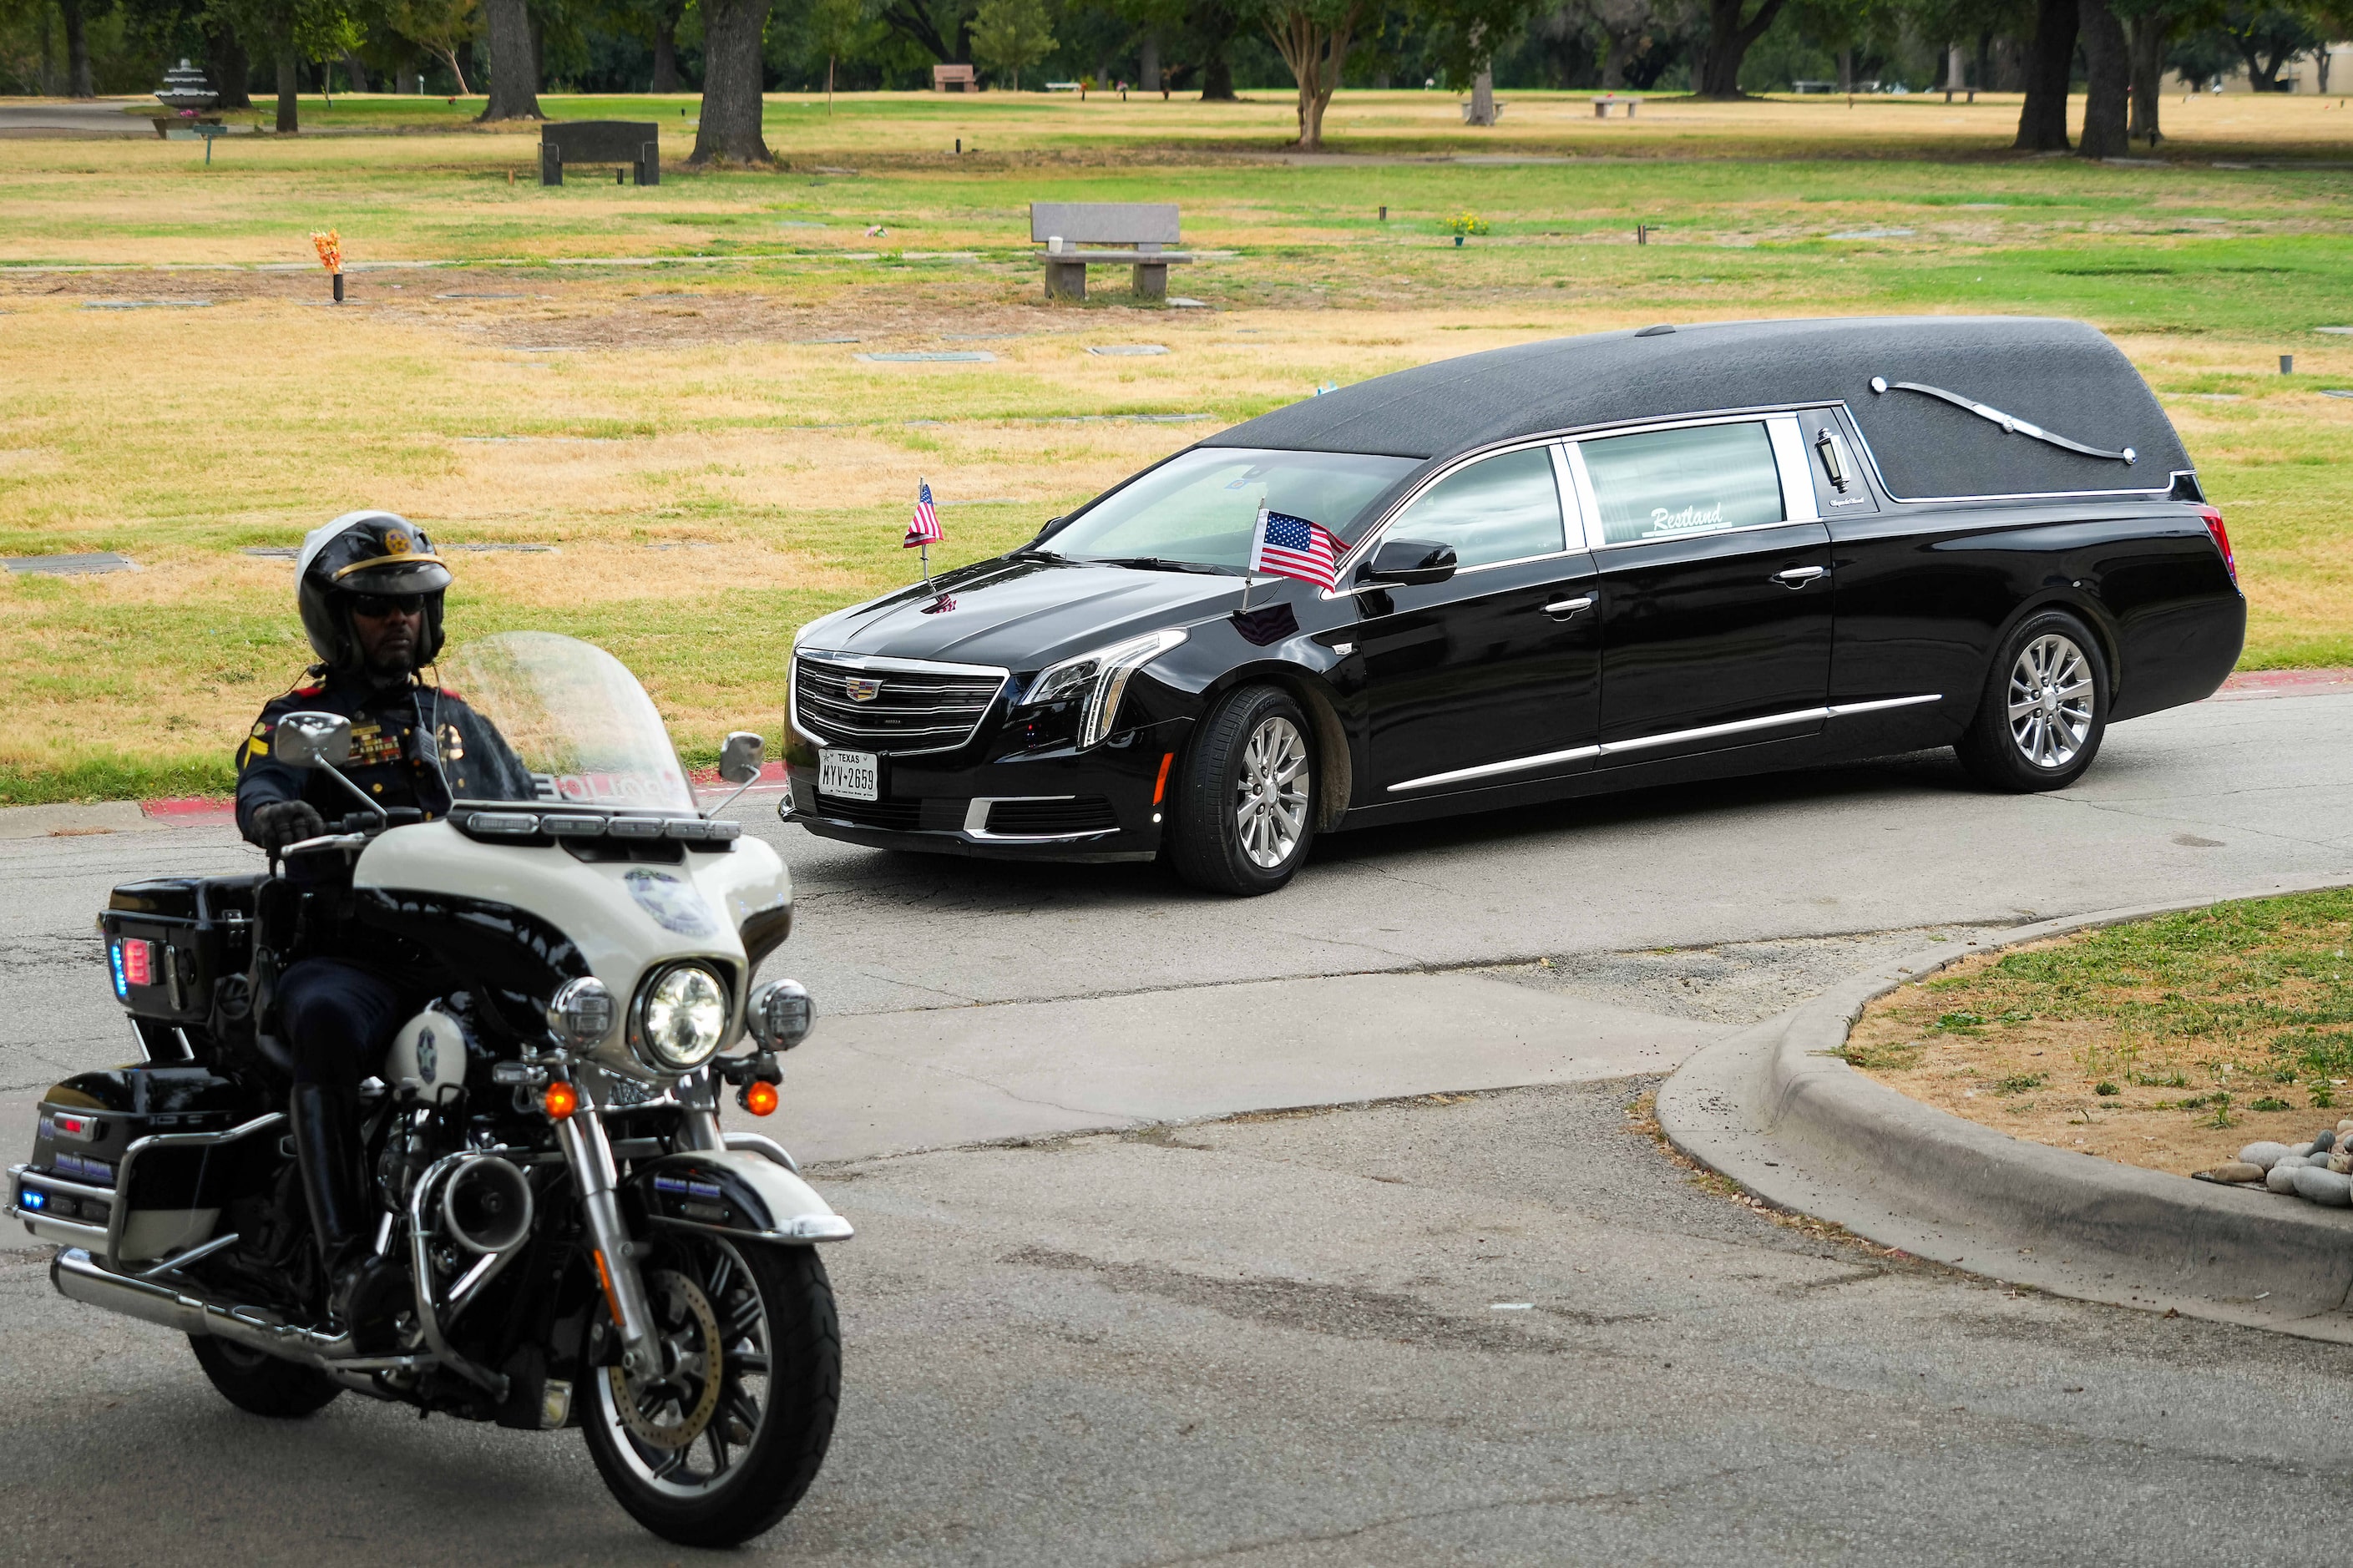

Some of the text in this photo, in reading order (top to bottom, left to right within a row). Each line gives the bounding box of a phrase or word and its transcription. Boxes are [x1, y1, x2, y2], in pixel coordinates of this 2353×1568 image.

[1651, 502, 1723, 530] Restland
[837, 753, 860, 764] TEXAS
[822, 765, 873, 790] MYV 2659
